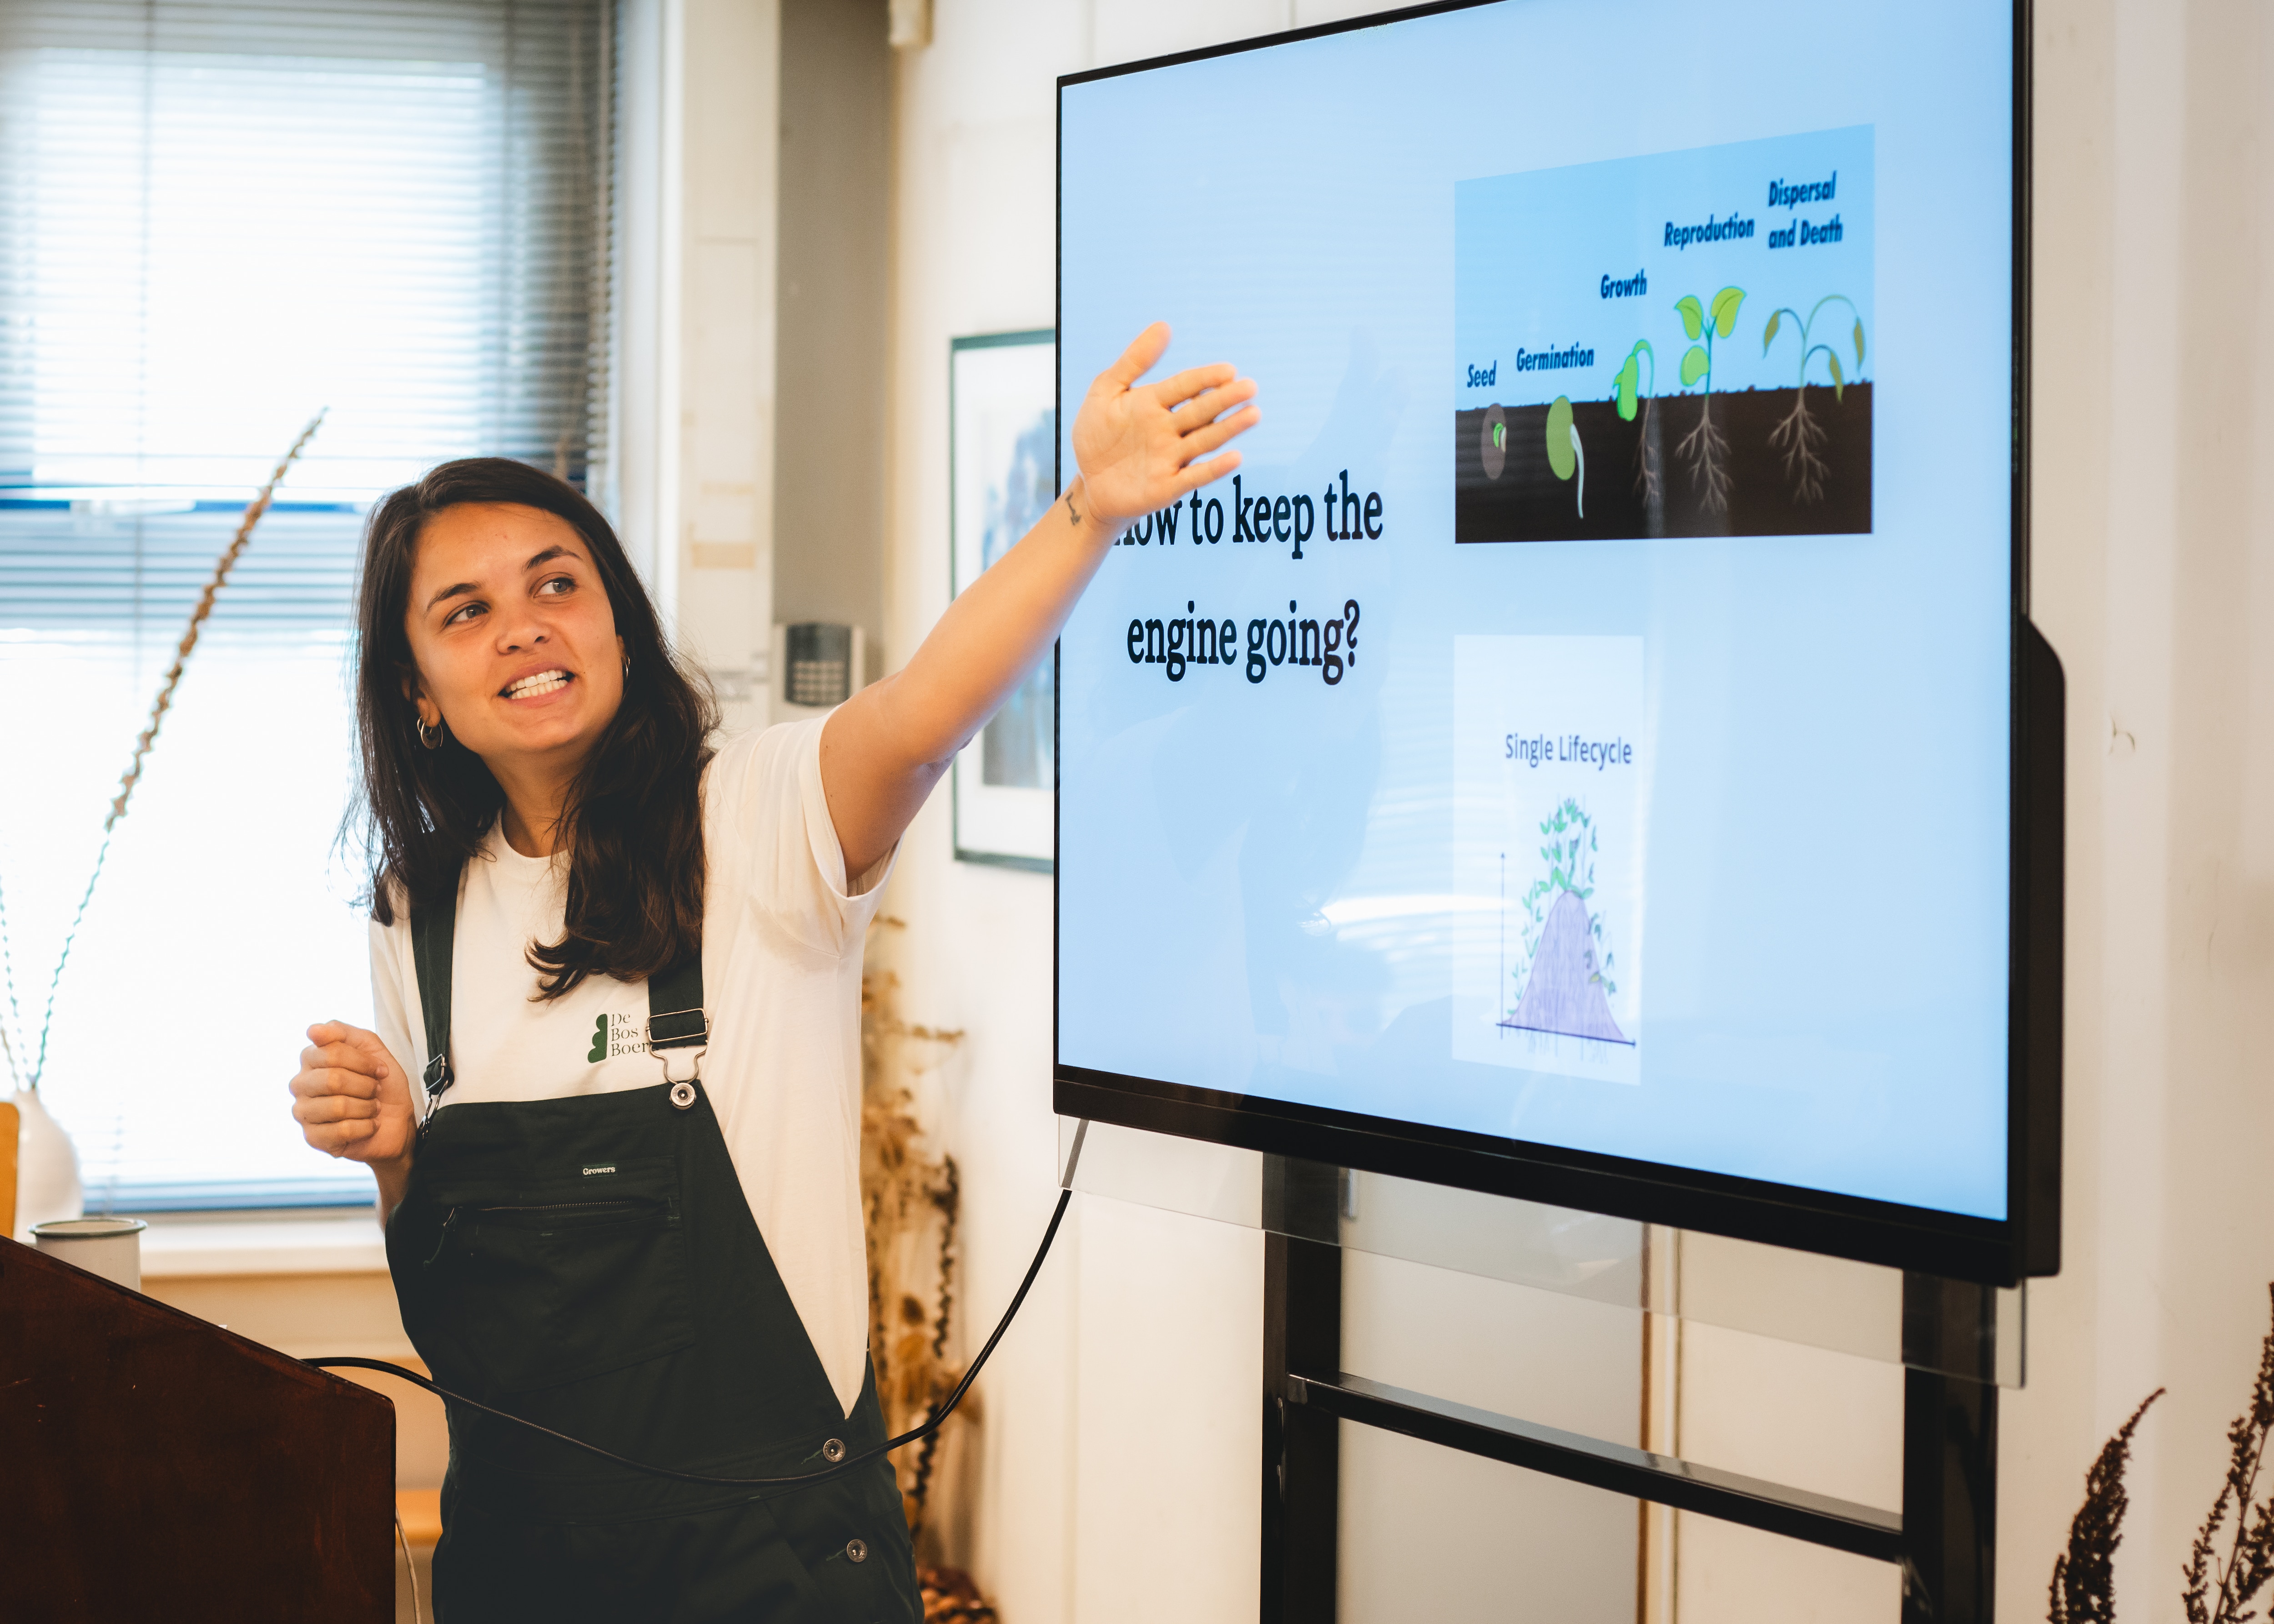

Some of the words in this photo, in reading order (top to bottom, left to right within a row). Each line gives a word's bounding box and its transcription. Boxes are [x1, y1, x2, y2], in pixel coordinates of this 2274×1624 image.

[1768, 170, 1836, 210] Dispersal
[1664, 212, 1754, 250] Reproduction
[1768, 218, 1796, 250] and
[1800, 213, 1843, 247] Death
[1600, 268, 1647, 299] Growth
[1467, 359, 1497, 388] Seed
[1516, 342, 1594, 372] Germination
[1113, 499, 1182, 546] ow
[1190, 488, 1224, 545] to
[1232, 474, 1314, 559] keep
[1323, 469, 1384, 540] the
[1127, 600, 1238, 682] engine
[1245, 598, 1360, 685] going?
[1505, 733, 1553, 768] Single
[1559, 735, 1632, 771] Lifecycle
[611, 1013, 631, 1027] De
[611, 1027, 639, 1042] Bos
[583, 1166, 616, 1176] Growers
